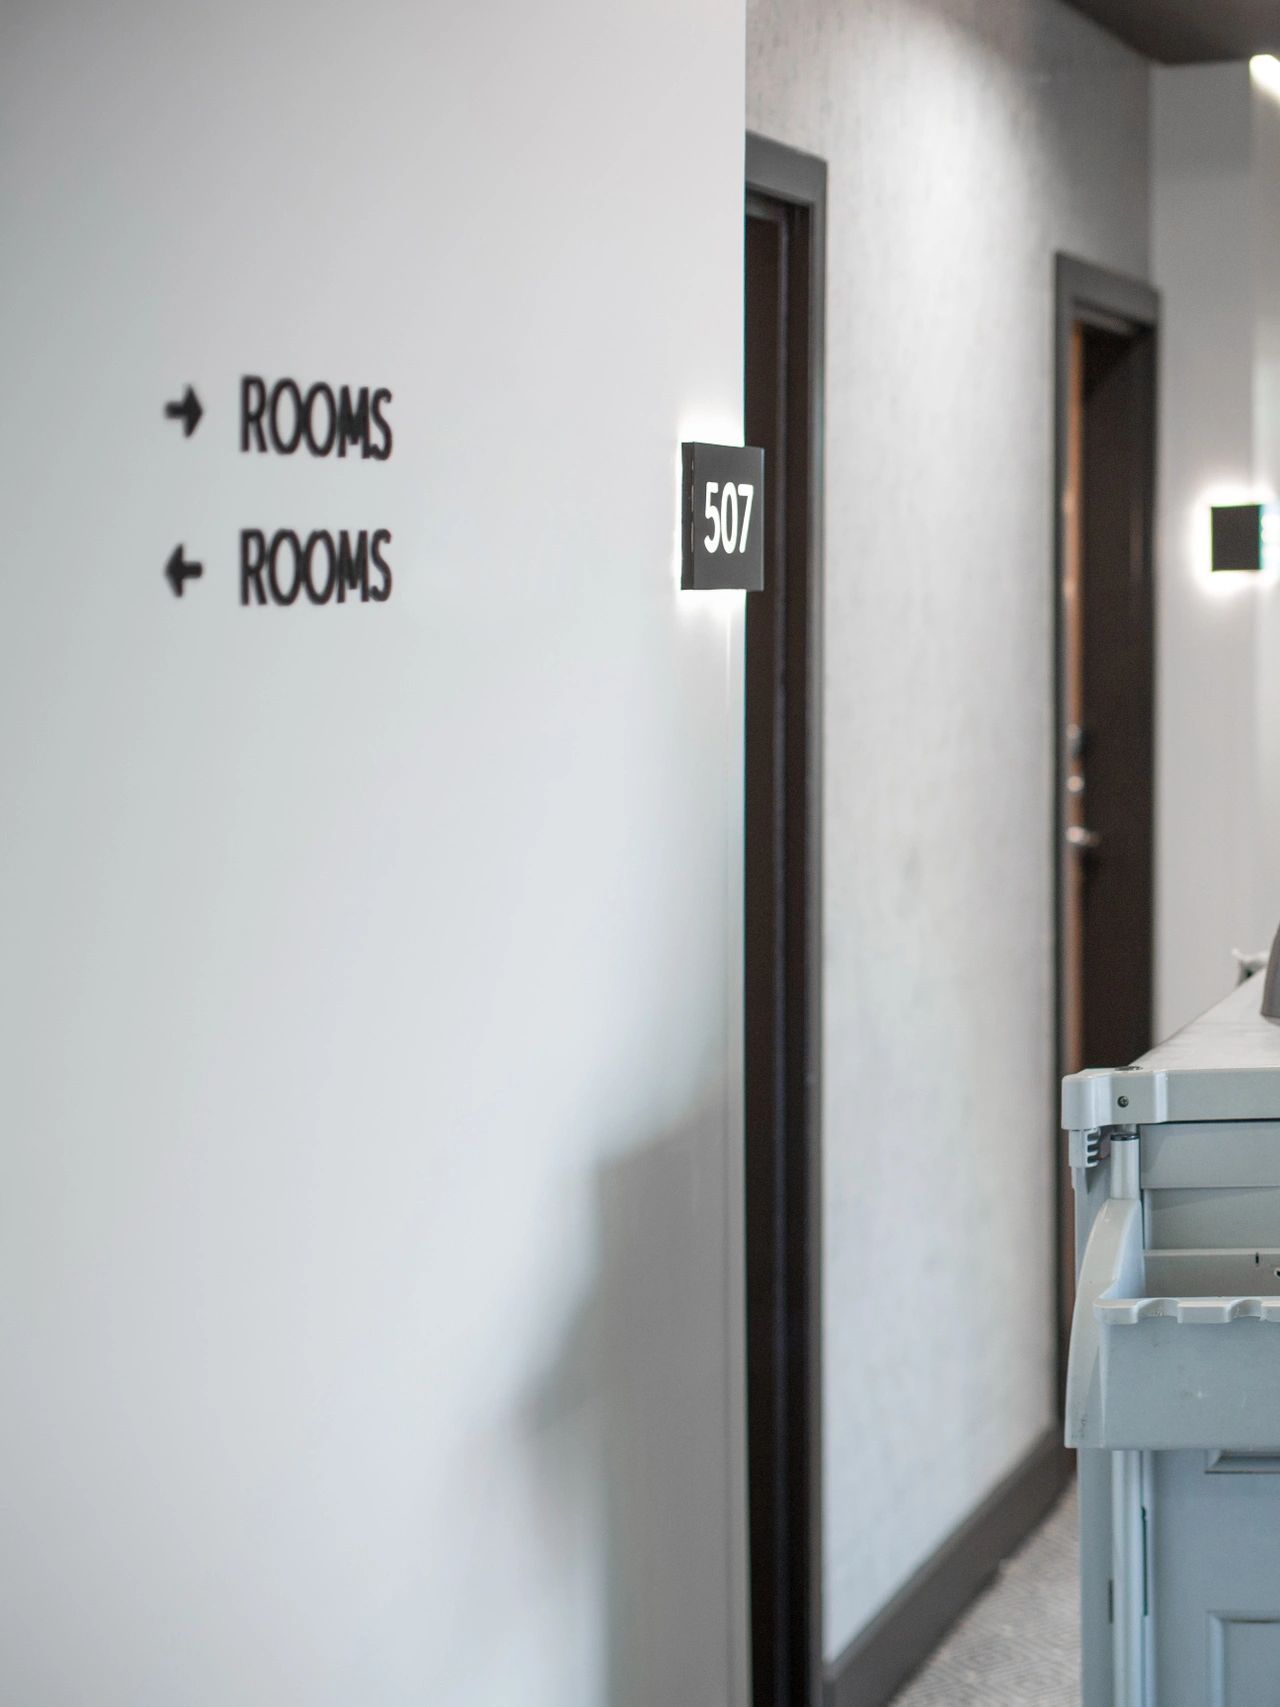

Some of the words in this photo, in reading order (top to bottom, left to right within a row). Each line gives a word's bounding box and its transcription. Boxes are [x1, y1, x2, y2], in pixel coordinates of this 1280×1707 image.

[239, 373, 393, 461] ROOMS
[704, 481, 754, 554] 507
[239, 527, 393, 607] ROOMS
